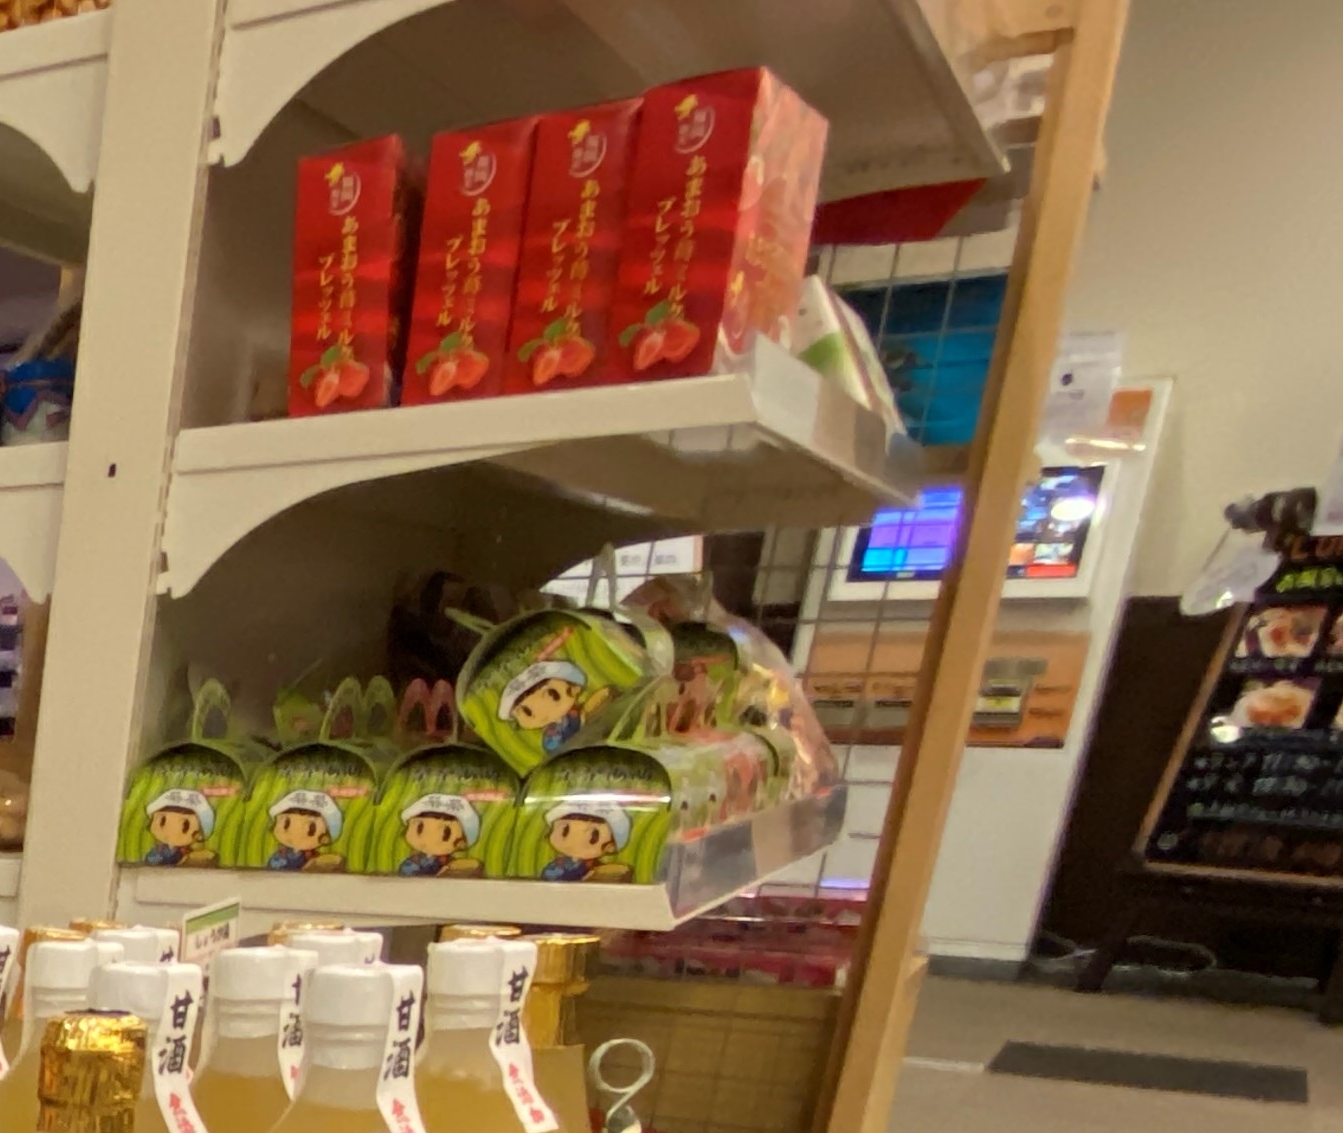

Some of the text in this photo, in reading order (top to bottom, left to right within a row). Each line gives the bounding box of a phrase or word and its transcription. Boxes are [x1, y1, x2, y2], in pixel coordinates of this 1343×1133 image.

[157, 989, 195, 1076] 甘酒
[383, 989, 416, 1081] 甘酒
[495, 965, 529, 1046] 甘酒
